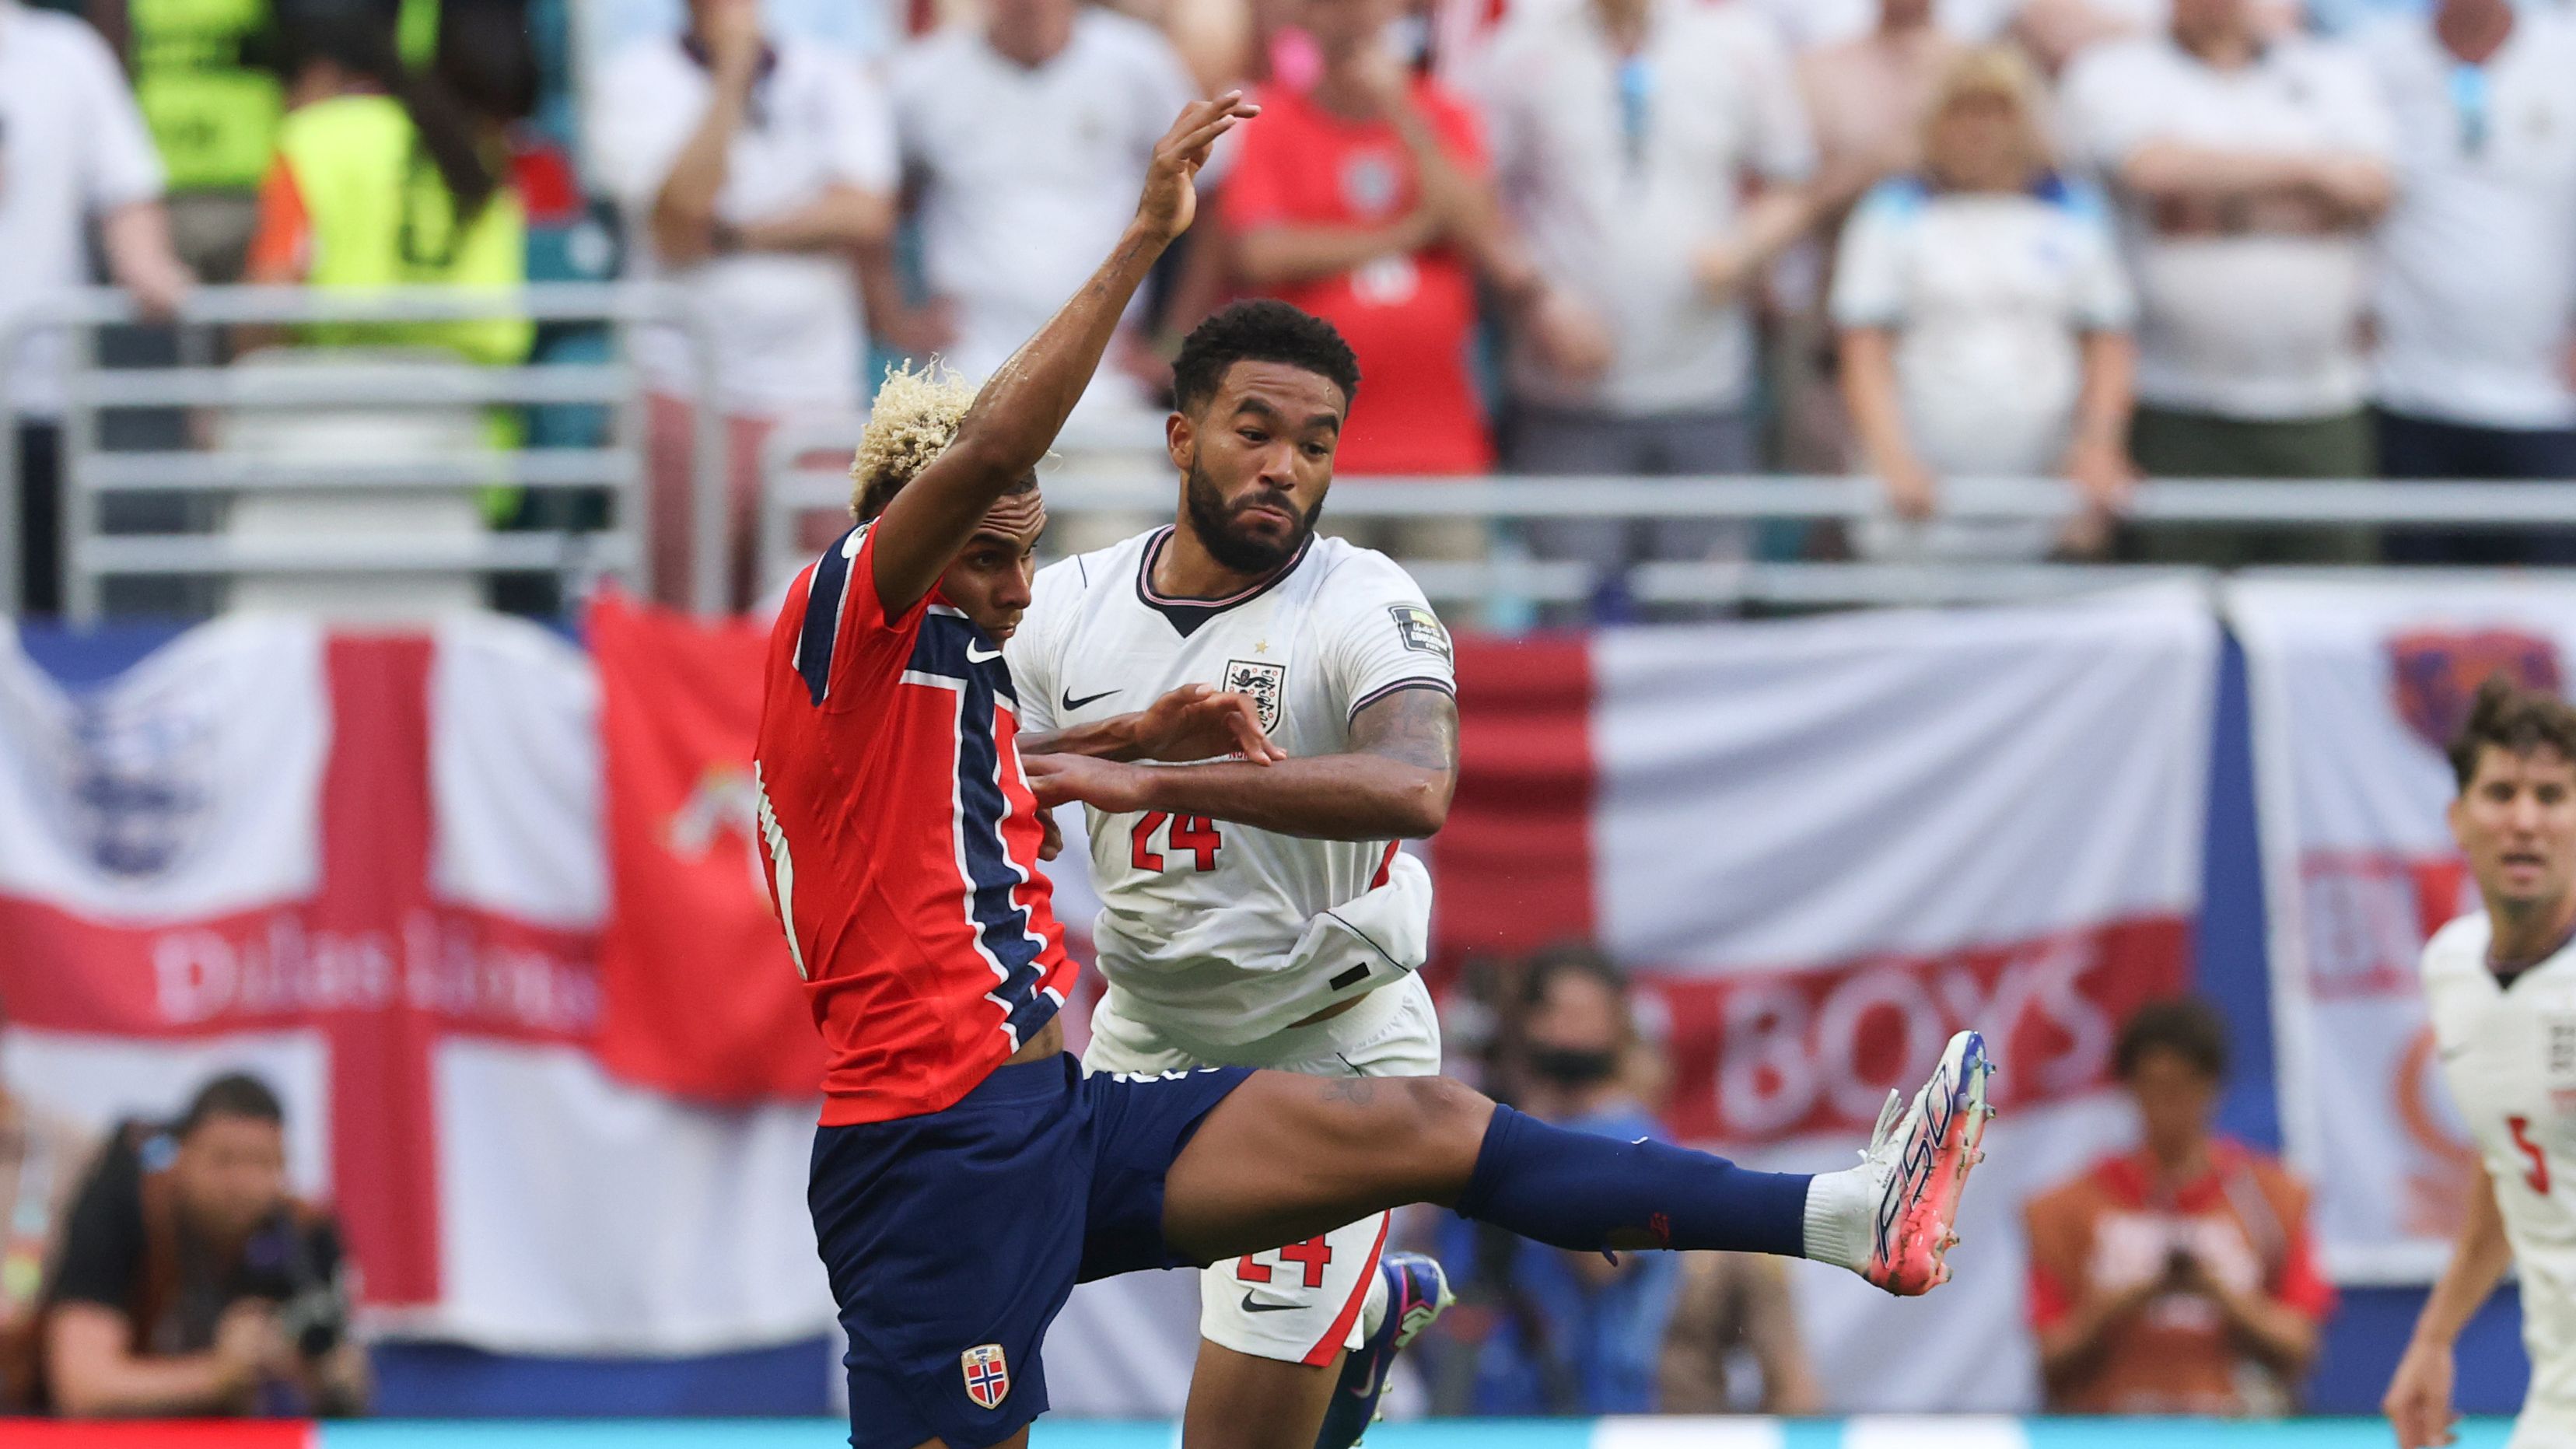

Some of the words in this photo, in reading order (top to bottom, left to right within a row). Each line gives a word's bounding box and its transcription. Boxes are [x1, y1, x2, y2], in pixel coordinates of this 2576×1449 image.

[1131, 810, 1222, 873] 24
[1717, 927, 2119, 1132] BOYS
[2504, 1114, 2550, 1195] 5
